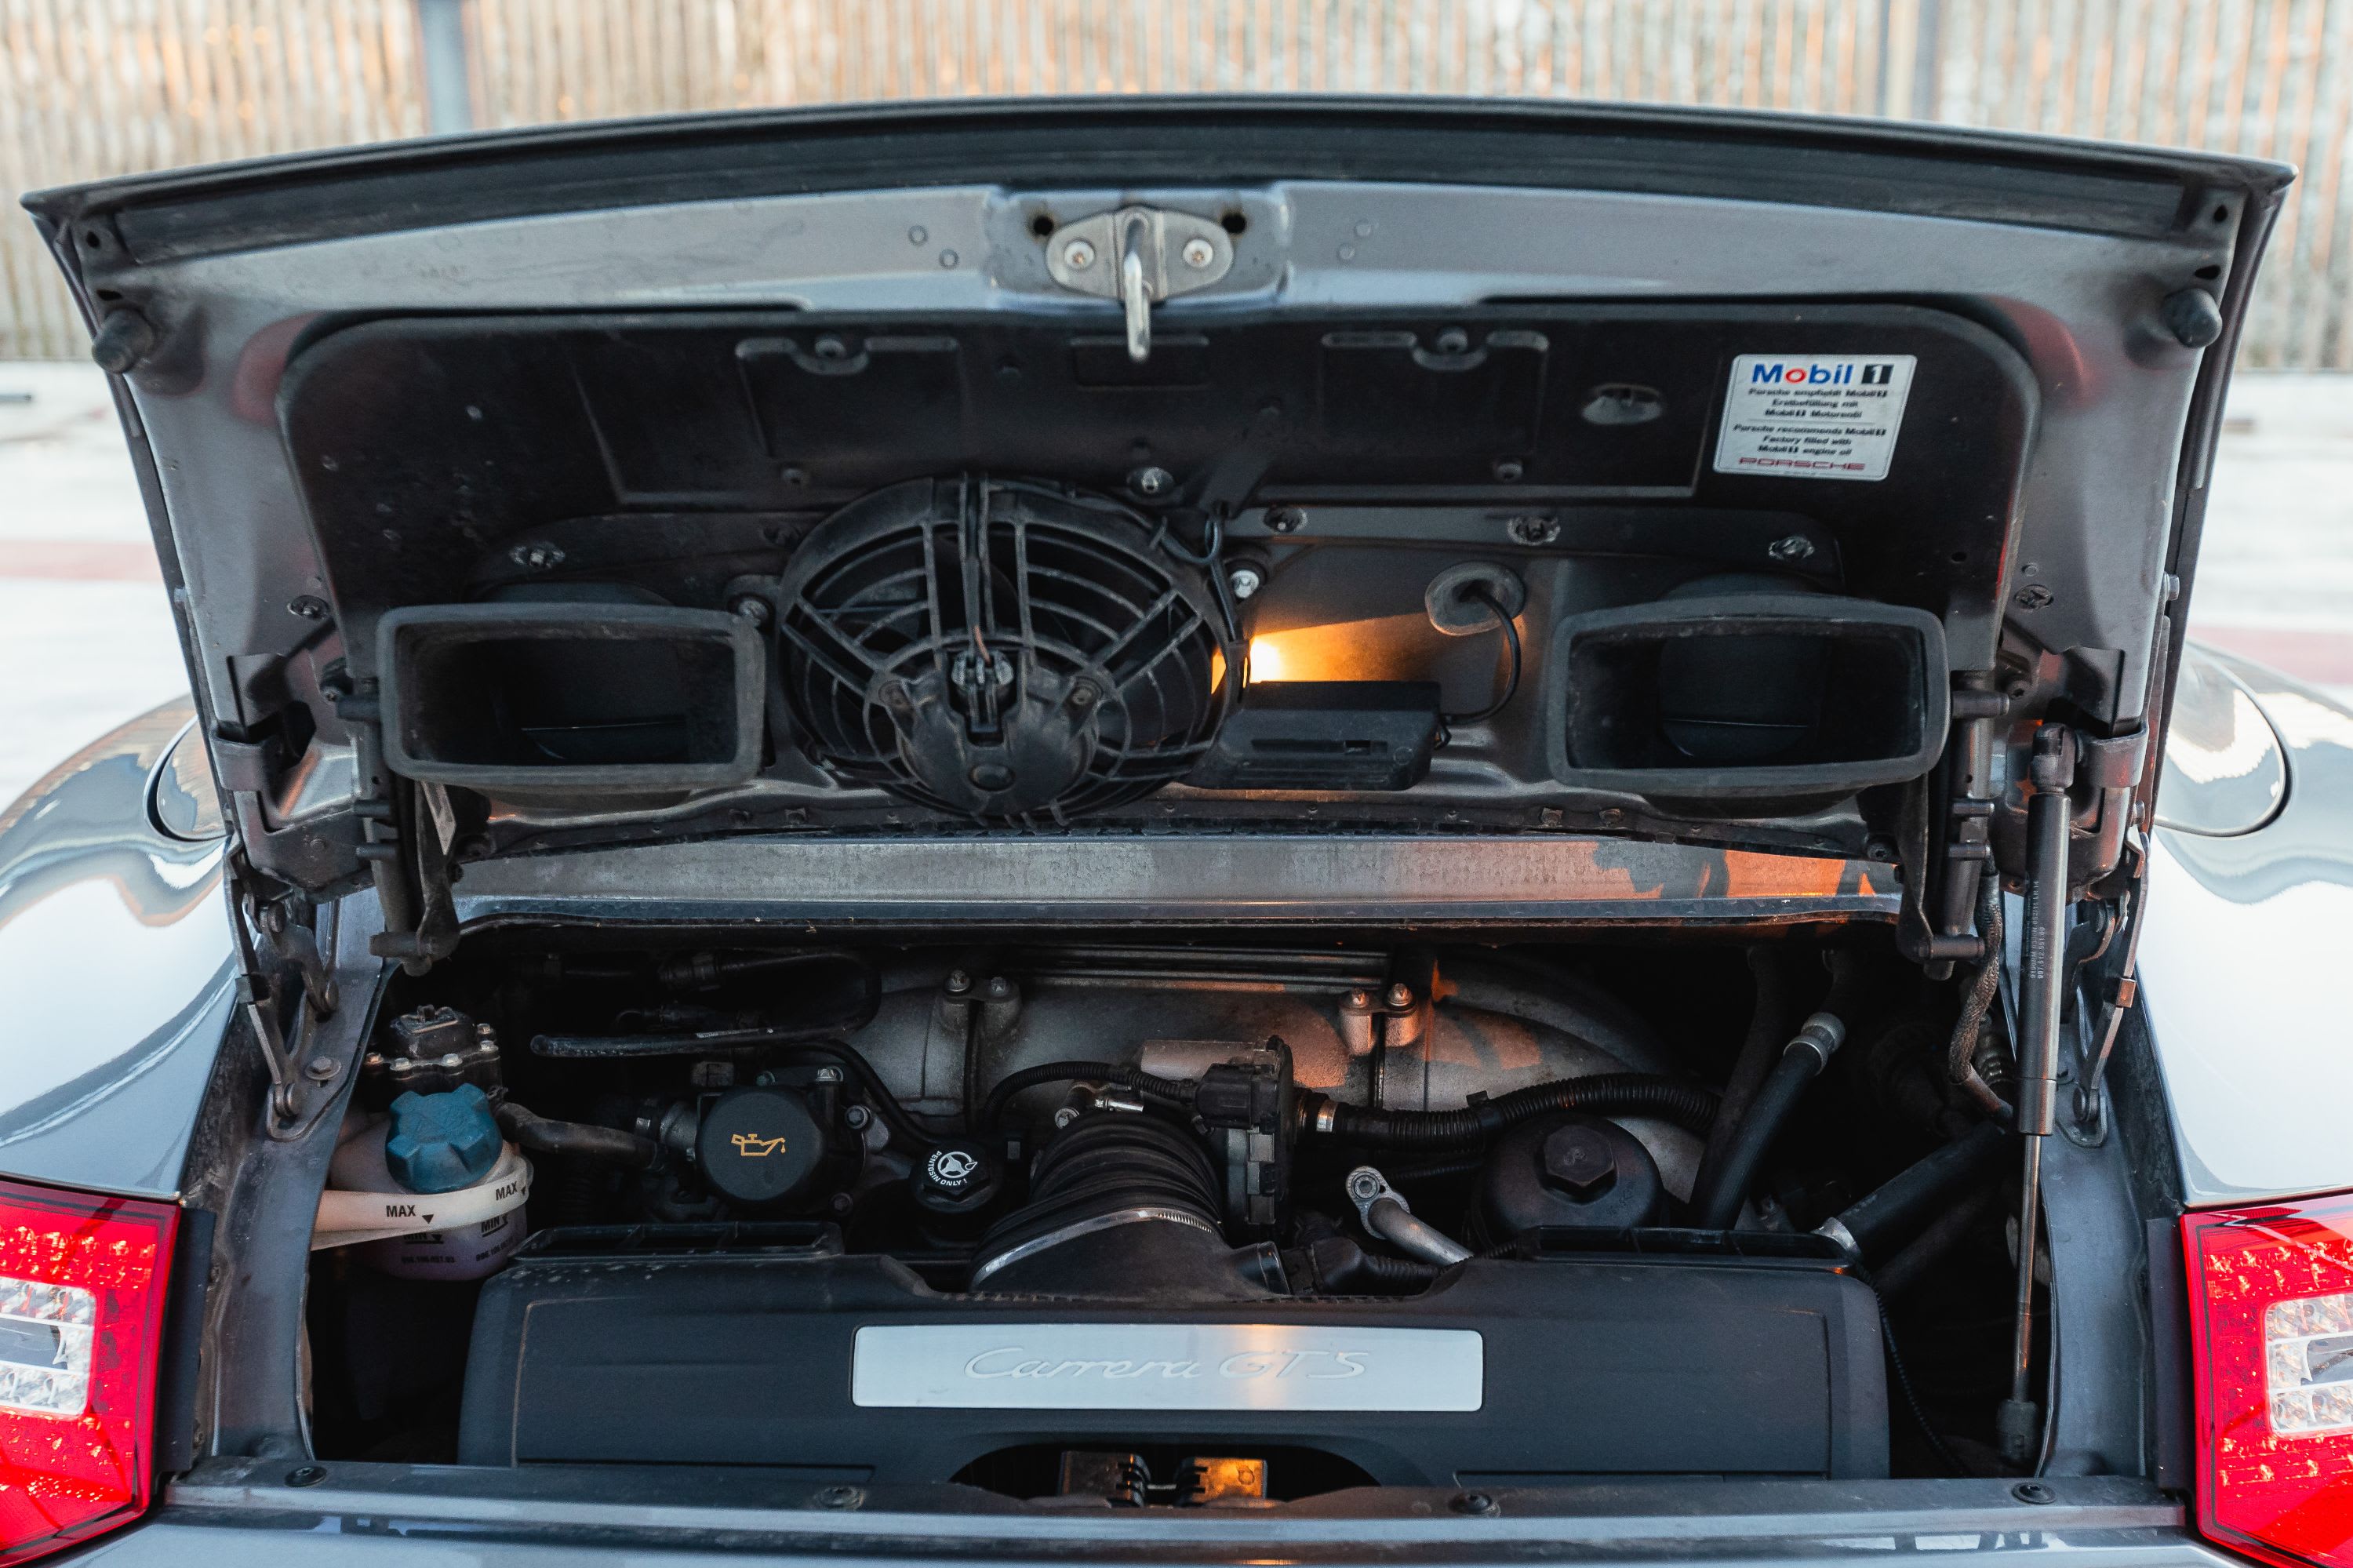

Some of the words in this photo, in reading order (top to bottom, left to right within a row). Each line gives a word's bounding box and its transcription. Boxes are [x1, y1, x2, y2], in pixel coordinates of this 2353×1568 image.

[1752, 363, 1853, 384] Mobil
[1763, 435, 1801, 444] Factory
[1738, 457, 1865, 471] PORSCHE
[927, 1150, 943, 1182] PENTOSIN
[496, 1181, 518, 1200] MAX
[386, 1205, 416, 1217] MAX
[482, 1217, 500, 1233] MIN
[964, 1346, 1198, 1379] Carrera
[1218, 1349, 1371, 1379] GTS
